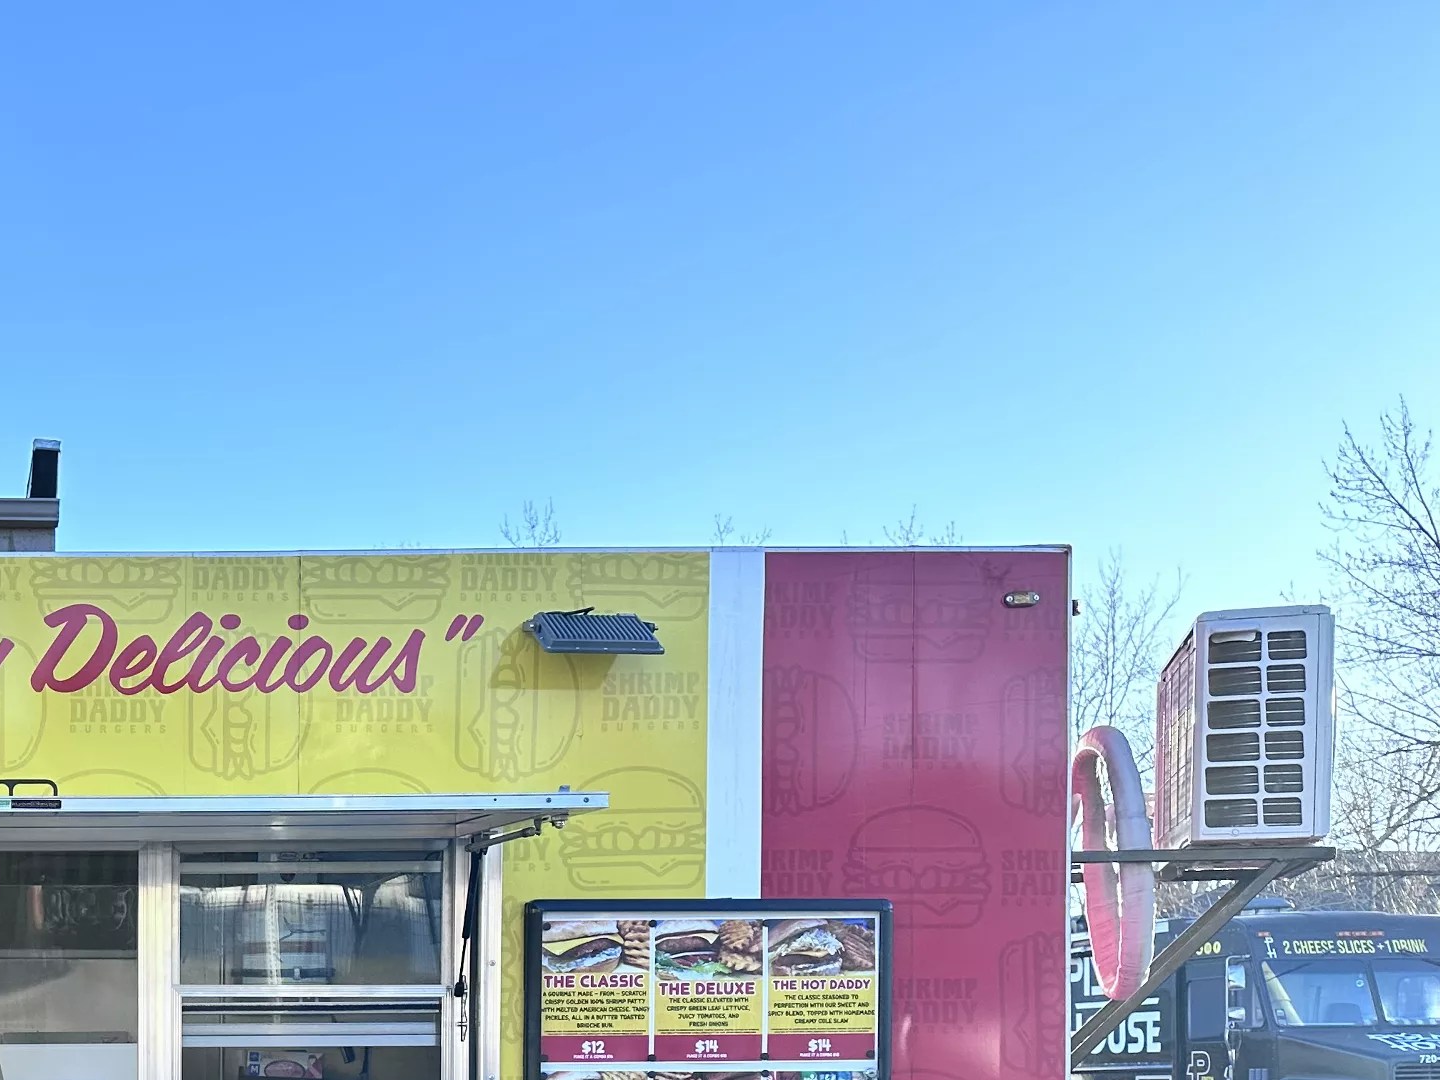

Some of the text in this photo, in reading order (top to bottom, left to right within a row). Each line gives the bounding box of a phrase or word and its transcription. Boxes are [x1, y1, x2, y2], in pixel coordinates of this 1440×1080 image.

[602, 672, 700, 695] SHRIMP
[601, 695, 699, 721] DADDY
[1282, 940, 1292, 955] 2
[1293, 940, 1337, 955] CHEESE
[1338, 940, 1375, 954] SLICES
[542, 974, 644, 989] THE CLASSIC
[658, 981, 756, 996] THE DELUXE
[772, 979, 871, 991] THE HOT DADDY
[581, 1040, 606, 1055] $12
[694, 1039, 719, 1054] $14
[807, 1038, 832, 1053] $14
